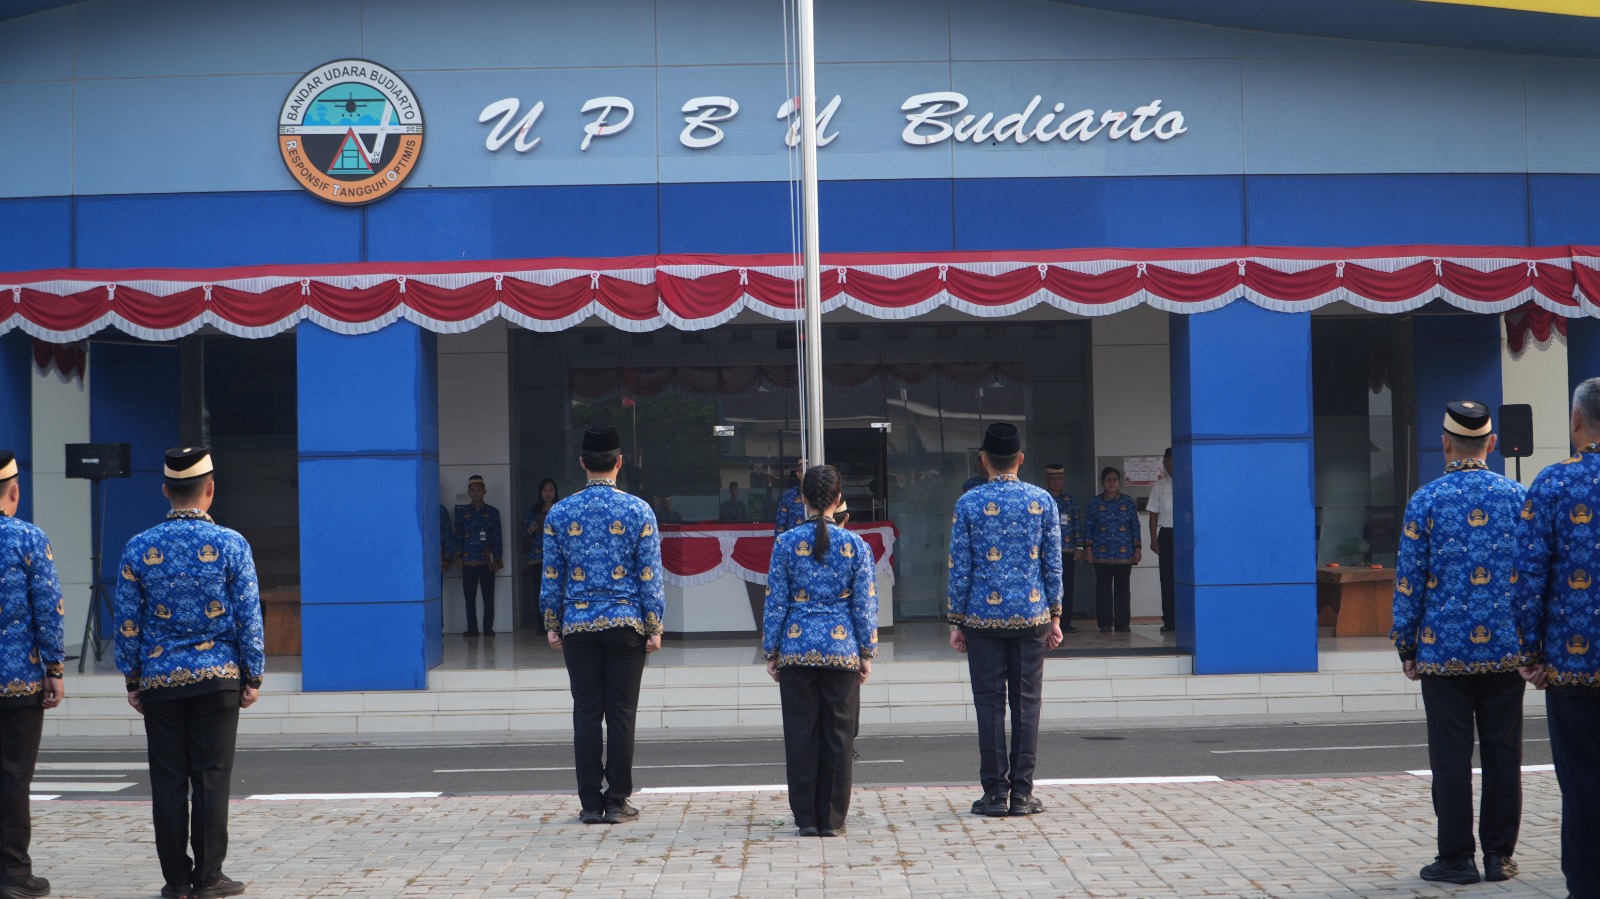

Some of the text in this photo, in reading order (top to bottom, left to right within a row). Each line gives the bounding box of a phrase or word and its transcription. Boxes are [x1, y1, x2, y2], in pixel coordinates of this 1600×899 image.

[287, 66, 415, 121] BANDAR UDARA BUDIARTO
[901, 92, 1188, 145] Budiarto
[285, 139, 416, 197] RESPONSIF TANGGUH OPTIMIS
